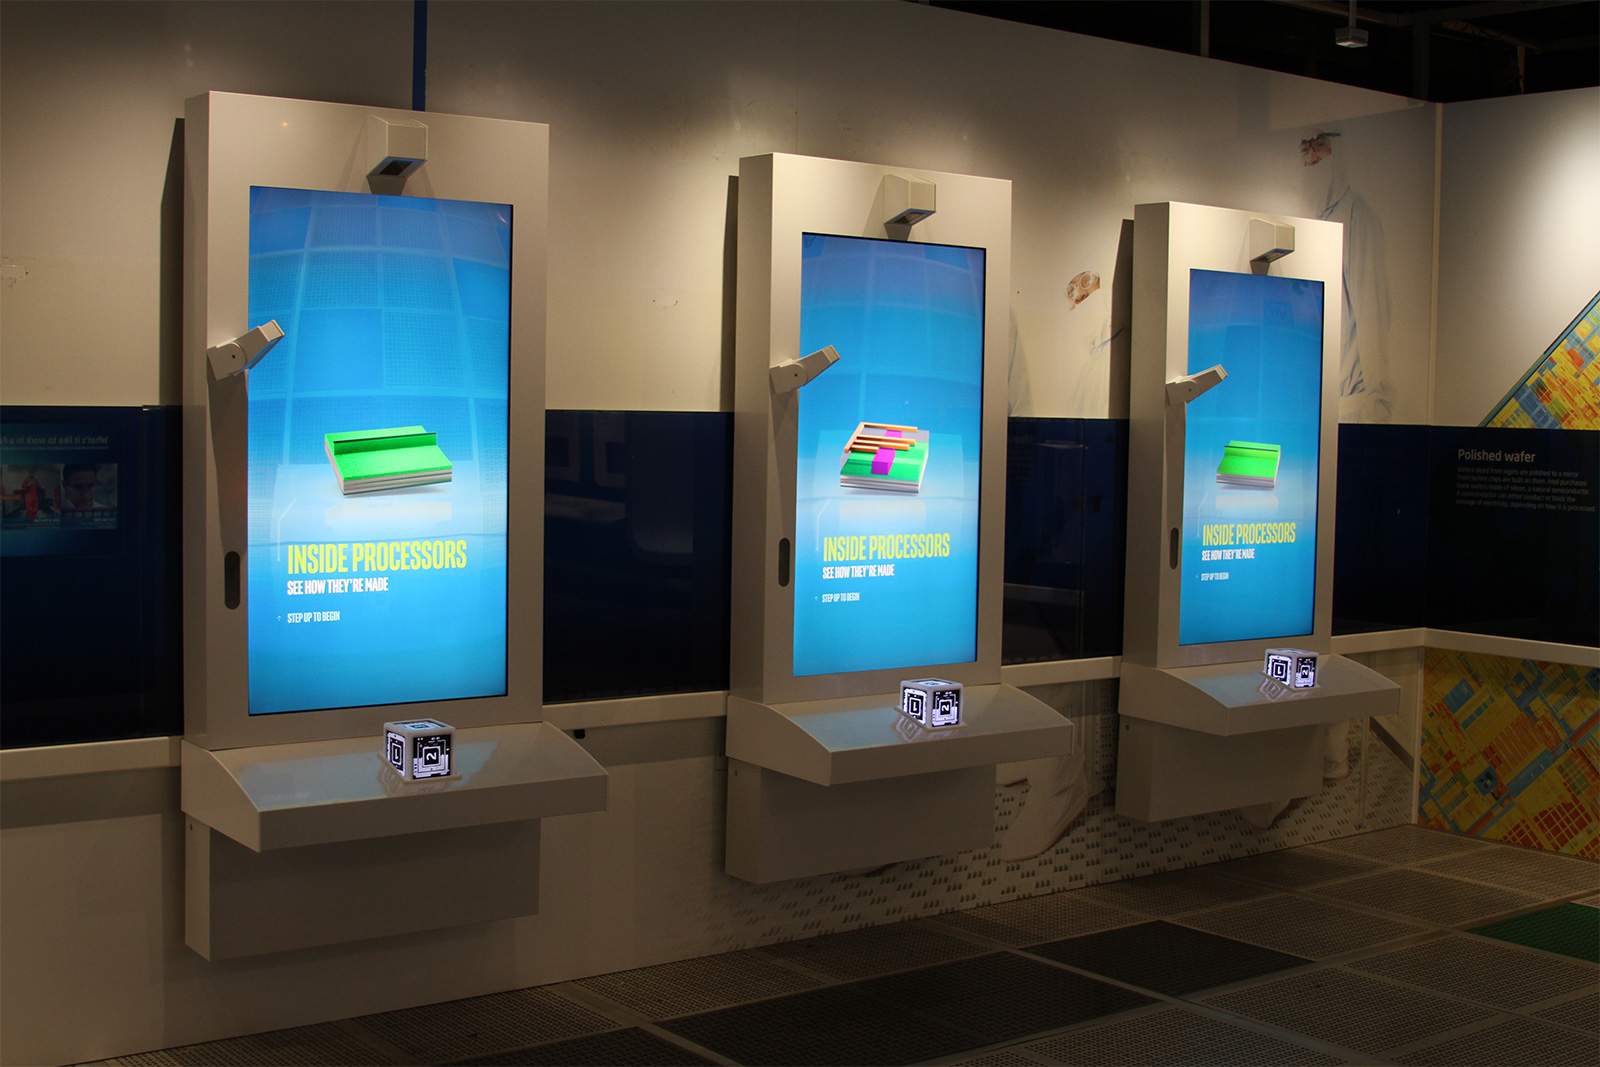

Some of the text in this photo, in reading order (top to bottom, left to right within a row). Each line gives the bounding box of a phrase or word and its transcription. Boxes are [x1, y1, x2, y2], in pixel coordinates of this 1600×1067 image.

[1458, 448, 1536, 463] Polished wafer
[1202, 522, 1296, 546] INSIDE PROCESSORS
[823, 533, 950, 562] INSIDE PROCESSORS
[1202, 550, 1210, 561] SEE
[1211, 549, 1222, 560] HOW
[1242, 548, 1255, 559] MADE
[287, 540, 467, 574] INSIDE PROCESSORS
[822, 566, 834, 579] SEE
[835, 566, 849, 578] HOW
[878, 564, 895, 576] MADE
[287, 577, 389, 595] SEE HOW THEY'RE MADE
[822, 592, 860, 603] STEP UP TO BEGIN
[287, 611, 340, 623] STEP UP TO BEGIN
